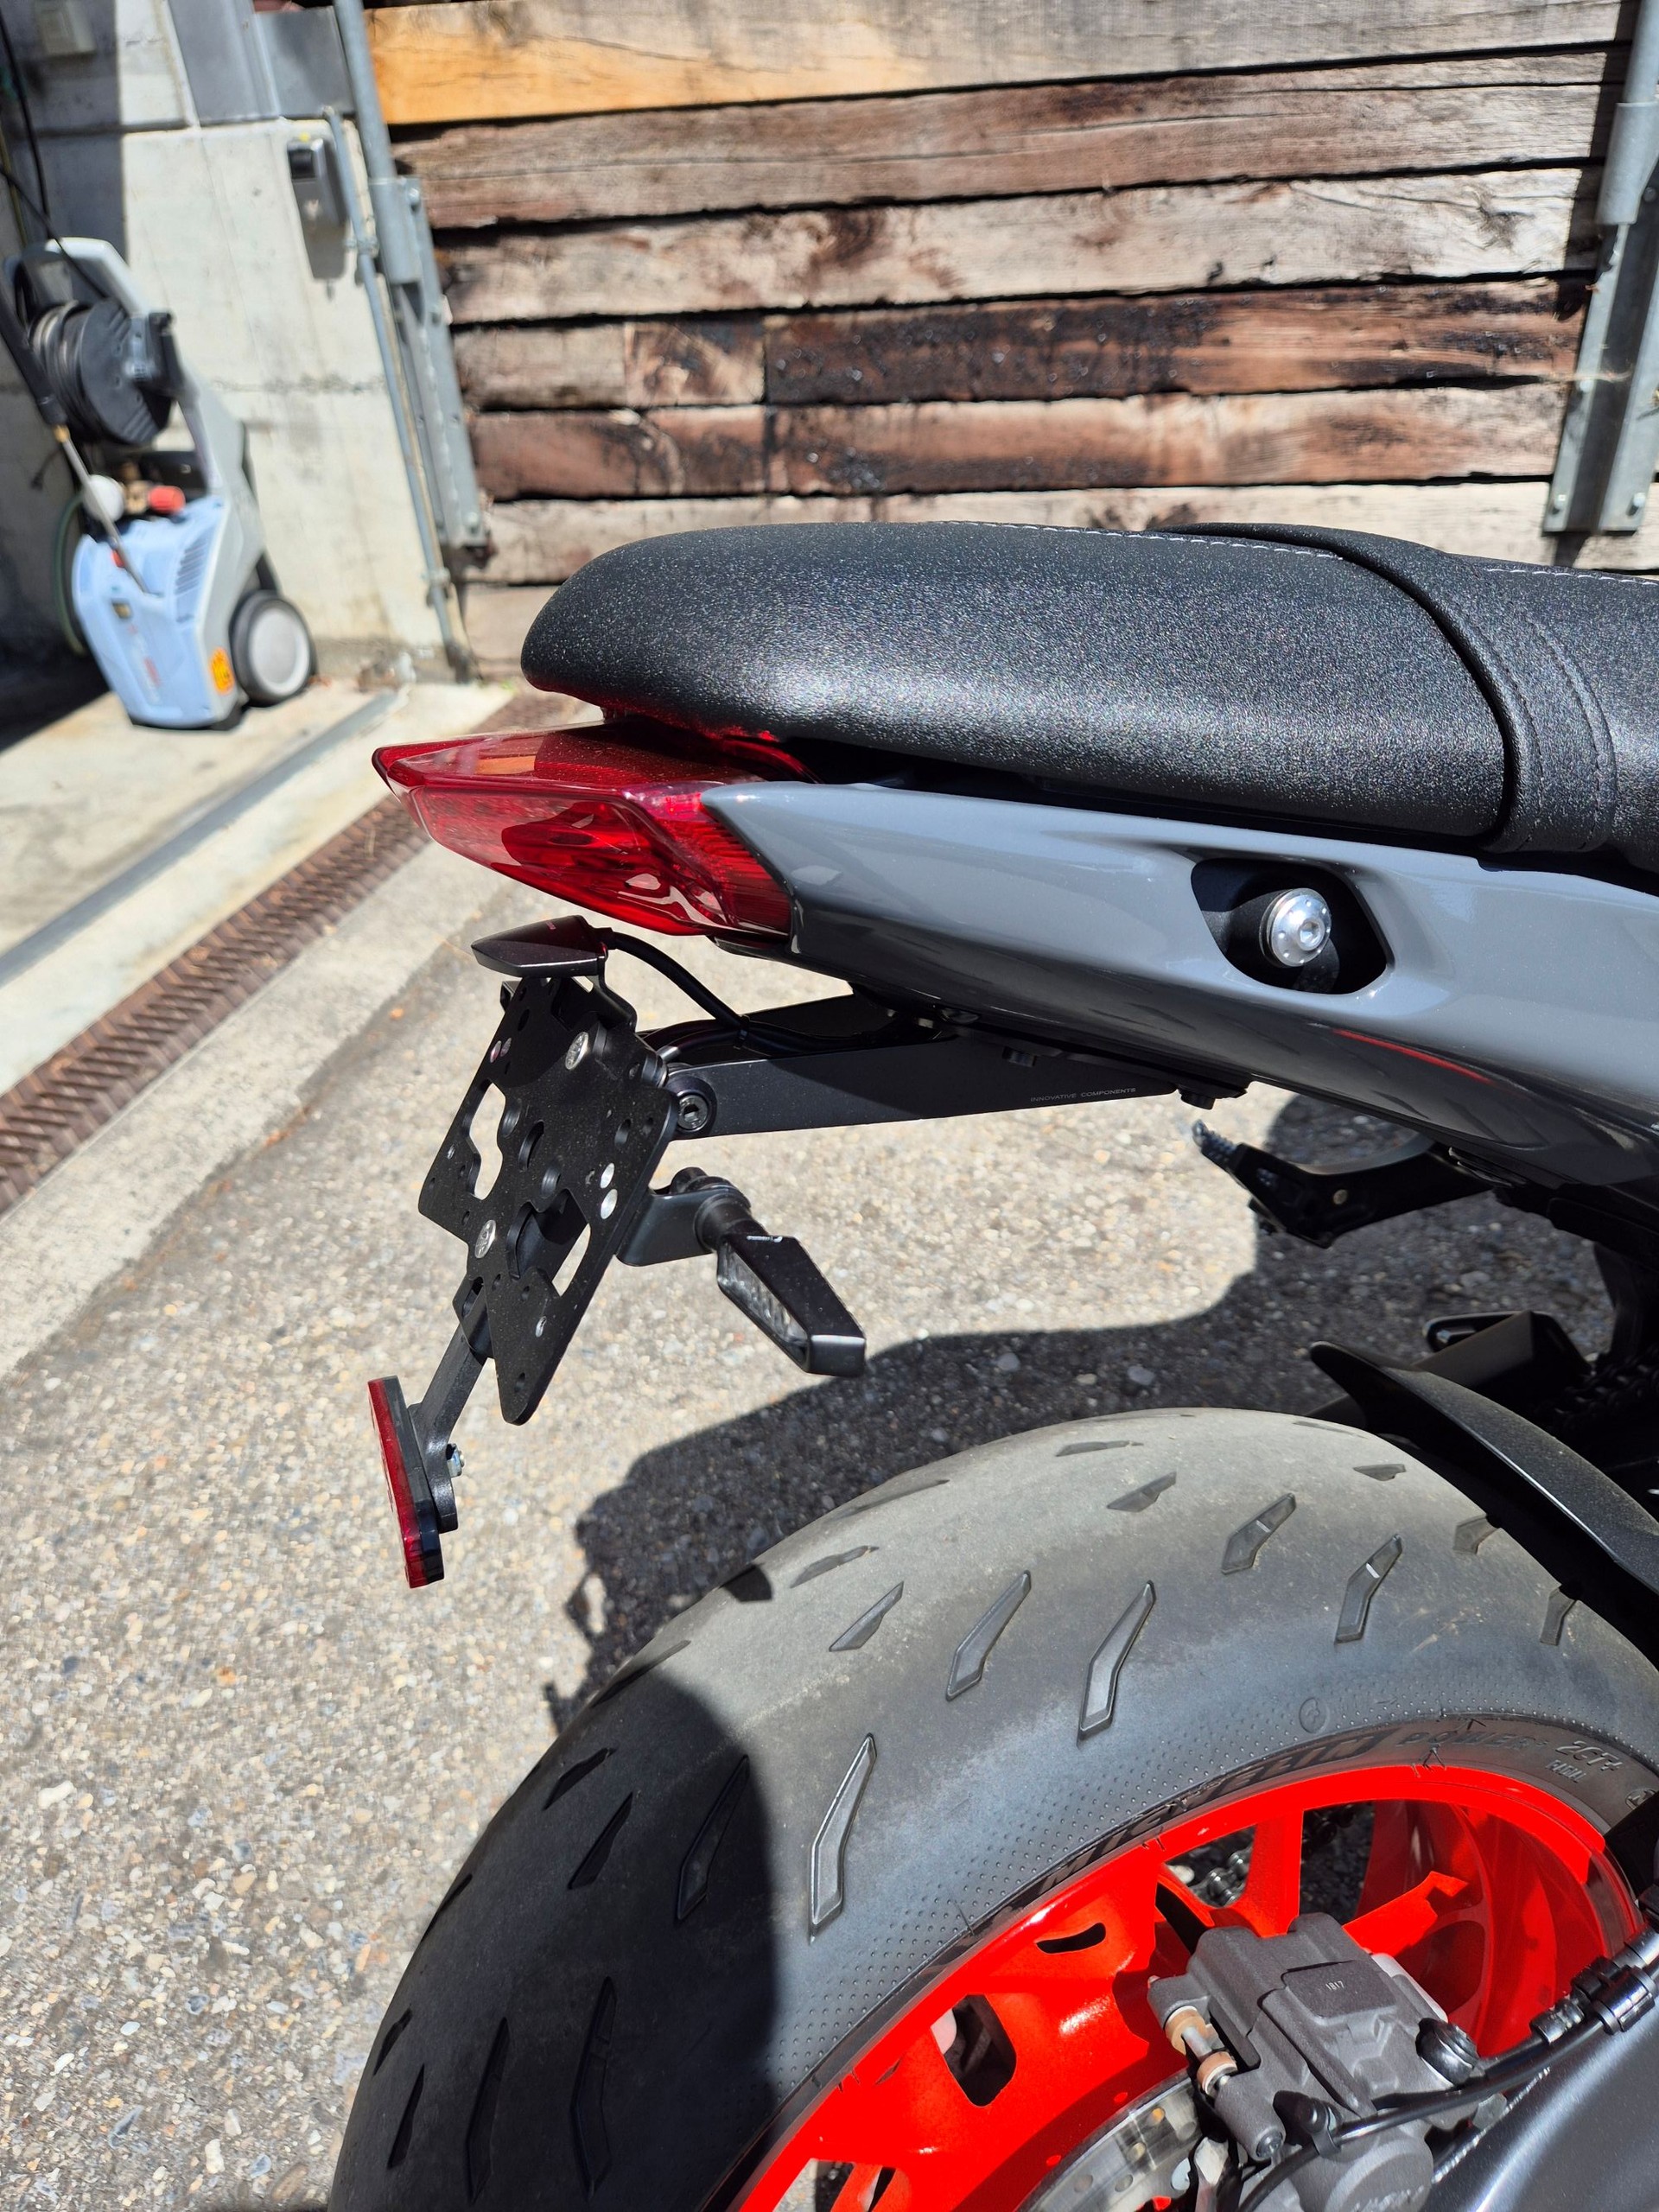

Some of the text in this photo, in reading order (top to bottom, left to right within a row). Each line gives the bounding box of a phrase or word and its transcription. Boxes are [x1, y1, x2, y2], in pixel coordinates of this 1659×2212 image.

[1030, 1087, 1136, 1103] INNOVATIVE COMPONENTS
[1325, 1980, 1344, 1991] 1817
